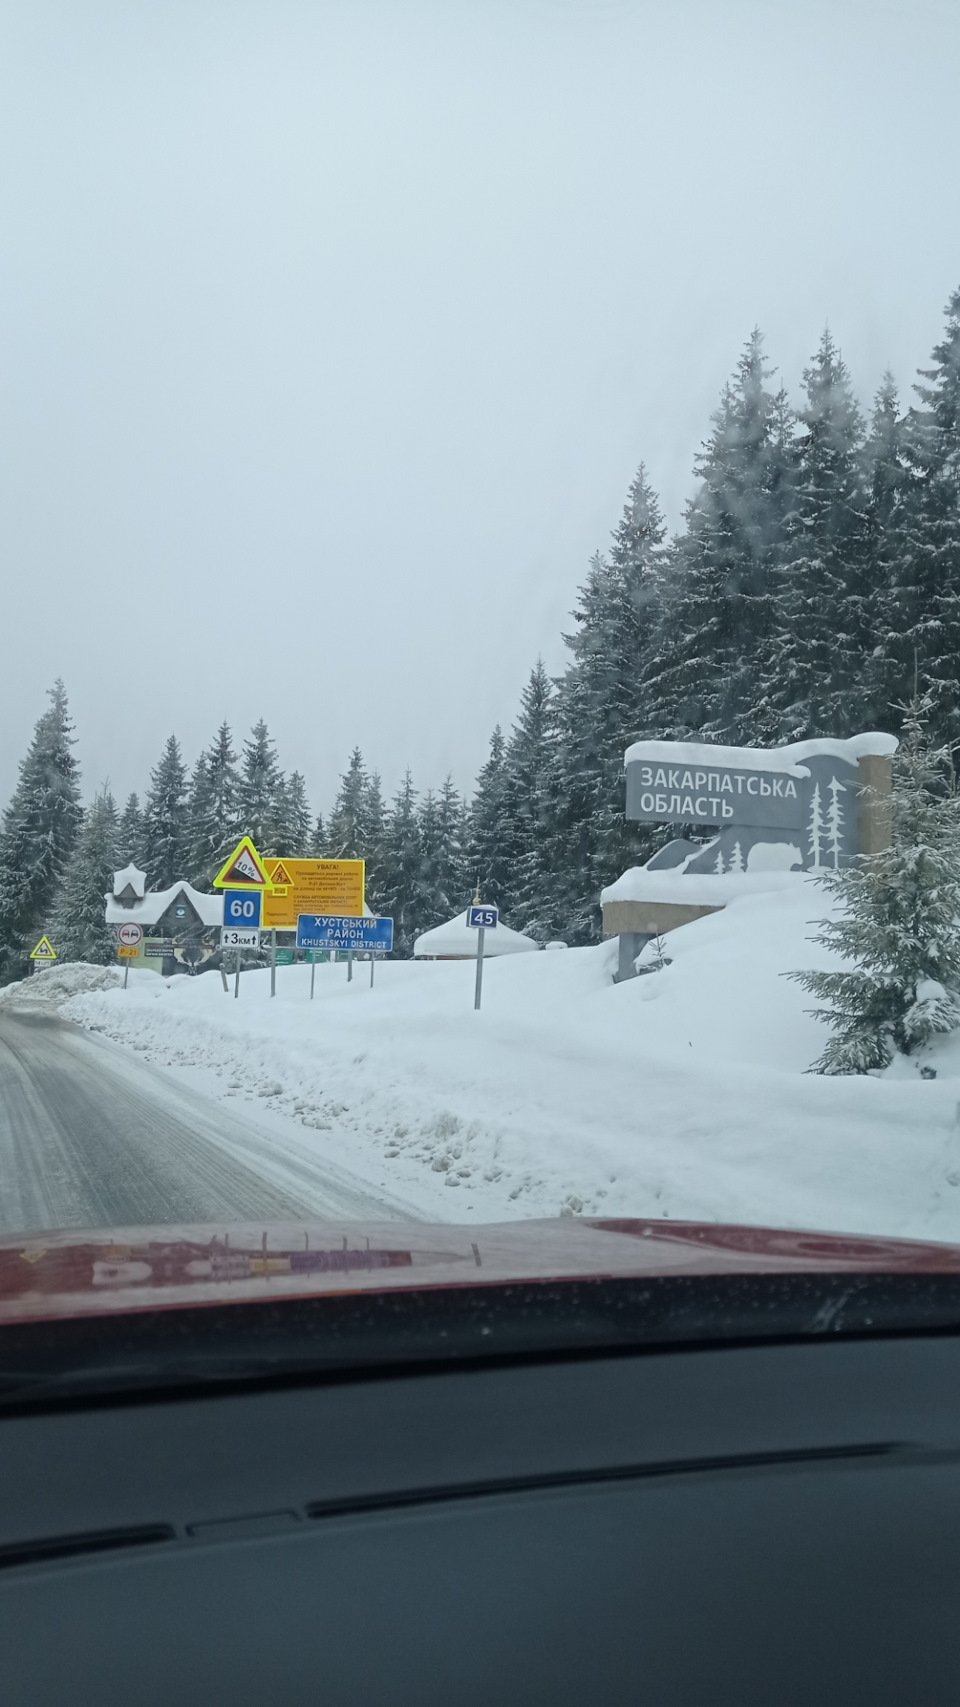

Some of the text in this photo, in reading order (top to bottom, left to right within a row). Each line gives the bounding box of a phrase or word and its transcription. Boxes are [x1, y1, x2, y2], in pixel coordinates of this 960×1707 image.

[640, 766, 798, 799] ЗАКАРПАТСЬКА
[640, 792, 734, 819] ОБЛАСТЬ
[230, 899, 255, 918] 60
[314, 917, 377, 929] ХУСТСЬКИЙ
[474, 911, 494, 925] 45
[327, 927, 364, 939] РАЙОН
[301, 938, 387, 949] KHUSTSKYI DISTRICT
